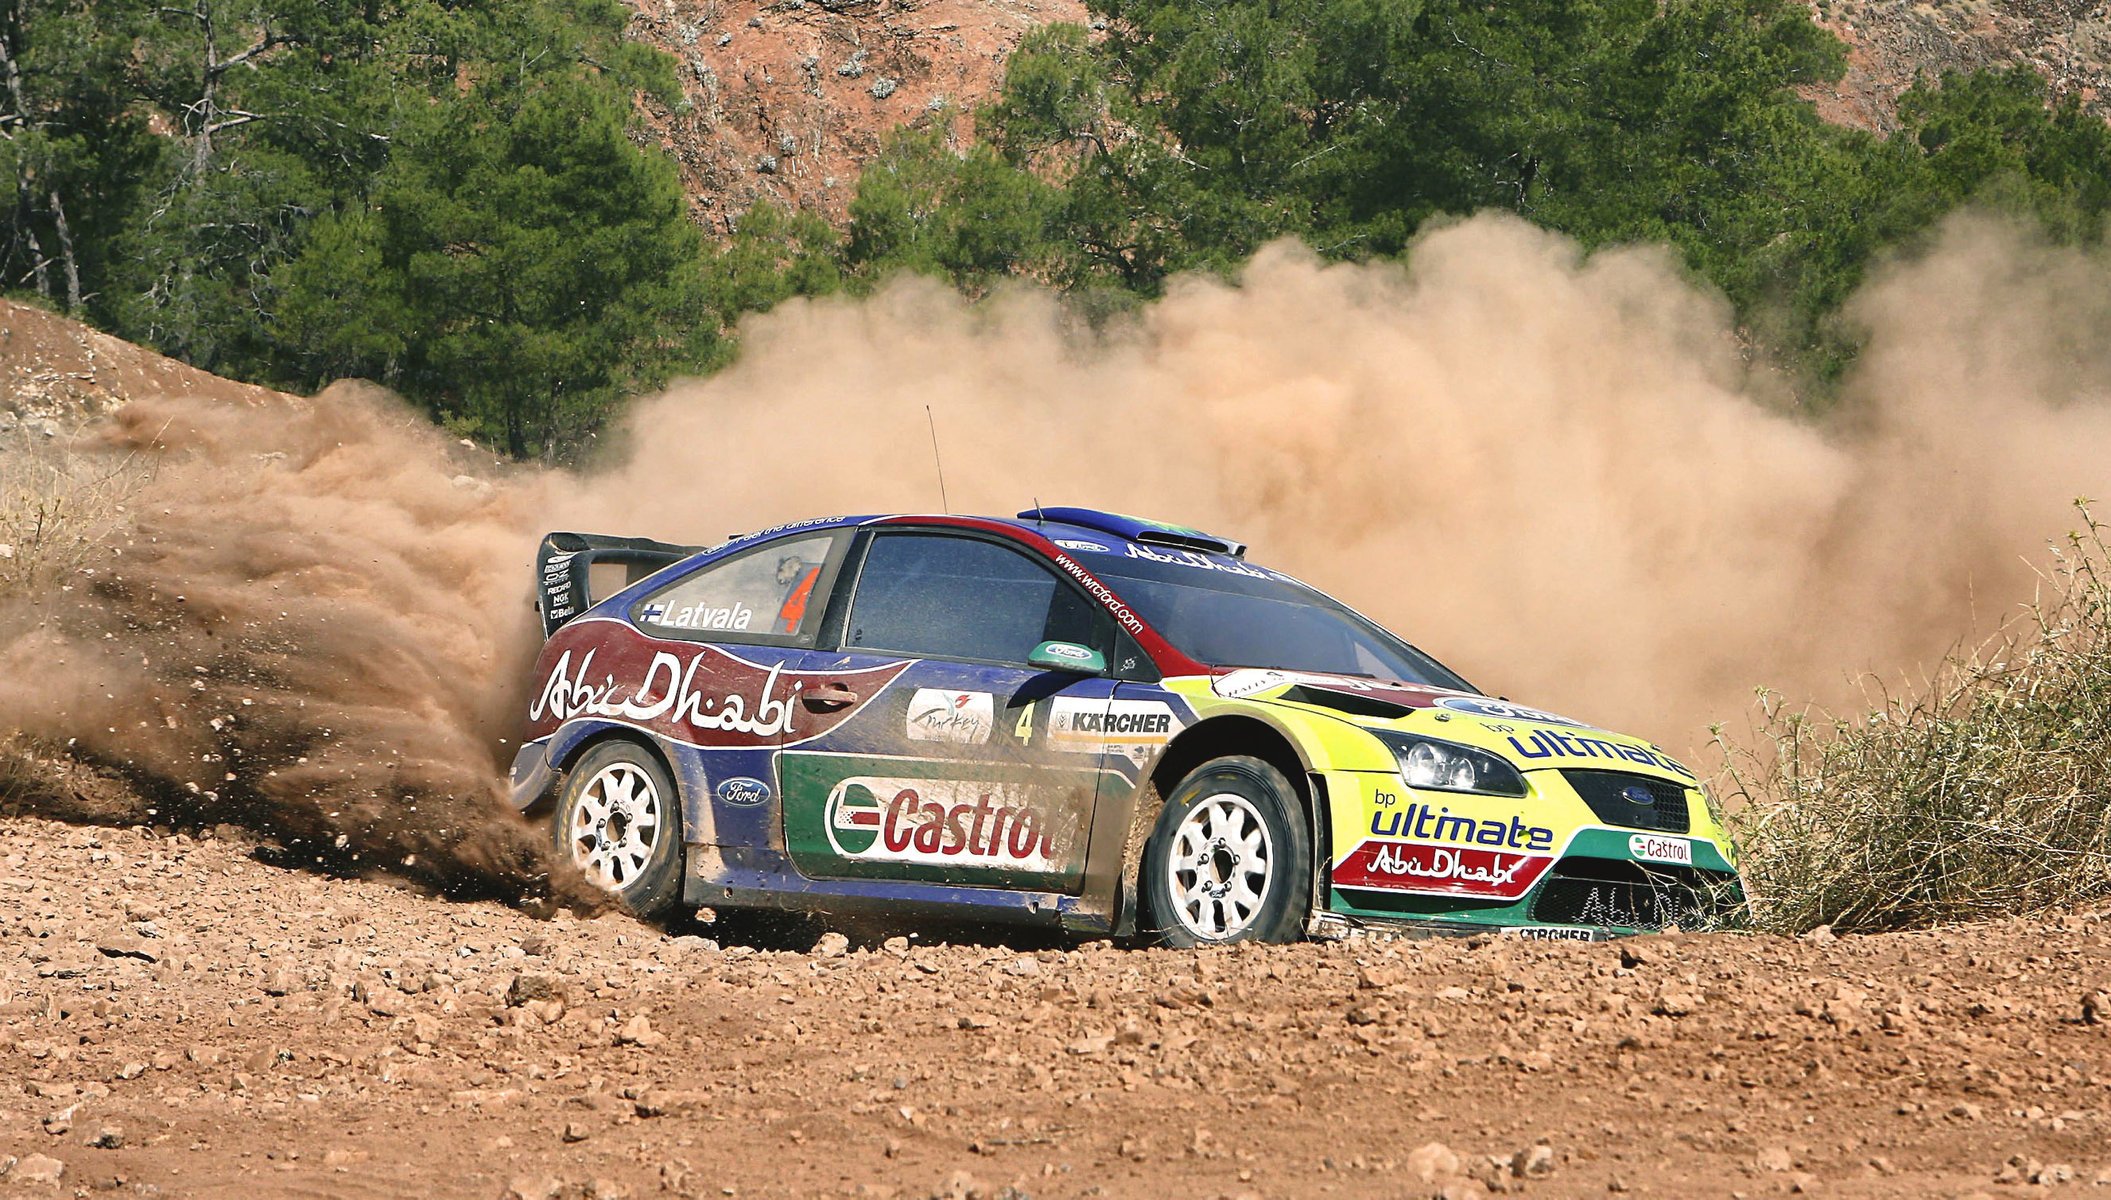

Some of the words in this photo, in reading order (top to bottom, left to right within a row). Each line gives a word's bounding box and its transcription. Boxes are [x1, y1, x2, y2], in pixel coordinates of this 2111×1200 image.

[553, 592, 569, 604] NGK
[778, 567, 820, 633] 4
[1055, 554, 1144, 635] www.wrcford.com
[660, 600, 752, 631] Latvala
[529, 647, 633, 723] Abu
[634, 650, 804, 737] Dhabi
[1014, 700, 1036, 747] 4
[1071, 711, 1171, 733] KÄRCHER
[1479, 722, 1515, 734] bp
[1507, 729, 1698, 782] ultimate
[725, 780, 761, 803] Ford
[1374, 788, 1396, 808] bp
[1371, 803, 1553, 851] ultimate
[1366, 844, 1426, 876] Abu
[1427, 848, 1518, 887] Dhabi
[1647, 839, 1688, 861] Castrol
